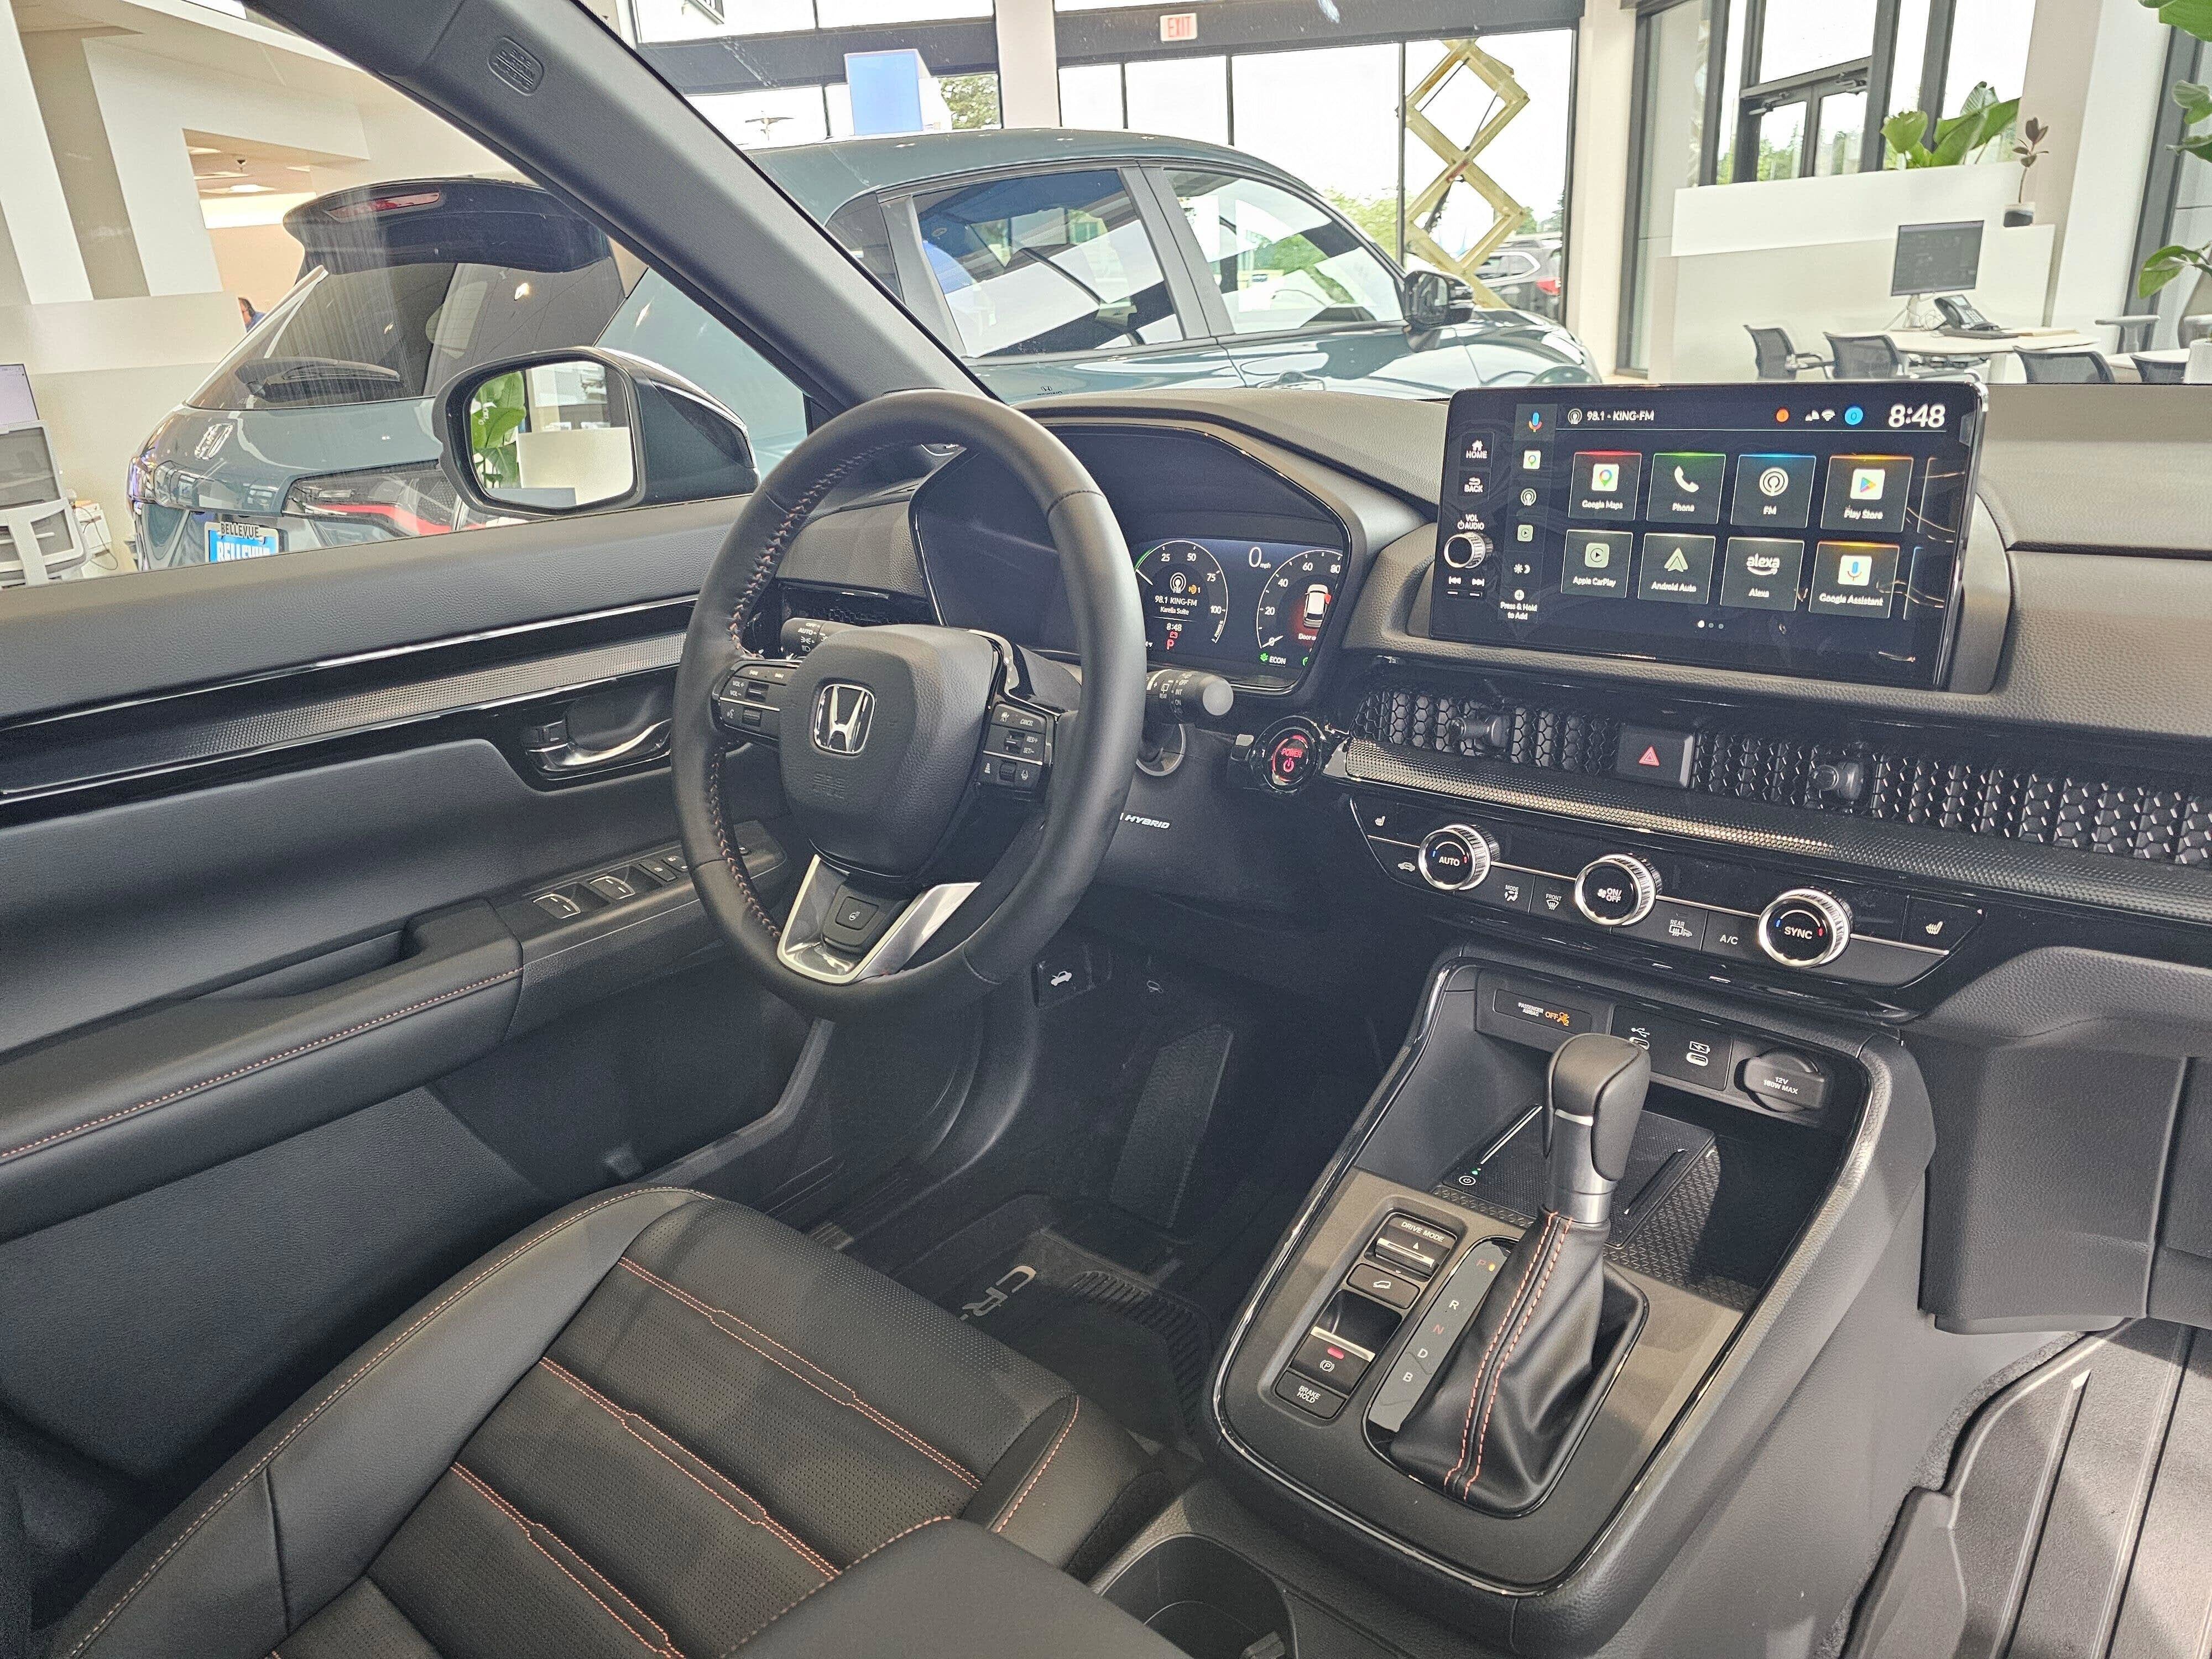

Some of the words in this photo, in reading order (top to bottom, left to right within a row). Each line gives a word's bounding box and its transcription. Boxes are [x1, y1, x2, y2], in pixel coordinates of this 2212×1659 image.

[1168, 16, 1192, 38] EXIT
[1587, 410, 1605, 421] 98.1
[1888, 403, 1945, 427] 8:48
[1466, 450, 1488, 459] HOME
[1464, 484, 1483, 493] BACK
[1582, 499, 1605, 509] Google
[1605, 500, 1623, 510] Maps
[1672, 502, 1695, 512] Phone
[1763, 505, 1777, 515] FM
[1844, 509, 1861, 520] Play
[1861, 509, 1884, 520] Store
[1465, 514, 1479, 522] VOL
[221, 523, 259, 538] BELLEVUE
[1465, 521, 1485, 530] AUDIO
[1161, 553, 1171, 562] 25
[1187, 552, 1197, 562] 50
[1249, 546, 1262, 567] 0
[1746, 553, 1780, 569] alexa
[1302, 562, 1313, 571] 60
[1331, 564, 1341, 573] 80
[1207, 573, 1216, 582] 75
[1277, 578, 1288, 587] 40
[1573, 576, 1592, 586] Apple
[1593, 578, 1616, 588] CarPlay
[1651, 581, 1679, 591] Android
[1679, 583, 1697, 592] Auto
[1749, 588, 1770, 598] Alexa
[1155, 595, 1168, 604] 98.1
[1170, 597, 1198, 607] KING-FM
[1819, 592, 1846, 604] Google
[1847, 594, 1884, 606] Assistant
[1211, 605, 1222, 614] 100
[1264, 607, 1275, 615] 20
[1500, 601, 1516, 610] Press
[1522, 603, 1538, 612] Hold
[1515, 612, 1528, 620] Add
[797, 627, 813, 635] AUTO
[1167, 623, 1182, 632] 8:48
[1167, 639, 1174, 650] P
[1269, 656, 1286, 665] ECON
[1281, 748, 1303, 758] POWER
[1124, 814, 1170, 829] HYBRID
[1438, 855, 1460, 867] AUTO
[1505, 884, 1519, 893] MODE
[1606, 888, 1622, 896] ON/
[1546, 893, 1562, 901] FRONT
[1606, 894, 1621, 902] OFF
[1784, 926, 1813, 940] SYNC
[1719, 934, 1739, 945] A/C
[1545, 1011, 1559, 1020] OFF
[1775, 1077, 1789, 1085] 12V
[1781, 1085, 1798, 1094] MAX
[1401, 1220, 1423, 1234] DRIVE
[1422, 1229, 1445, 1243] MODE
[1448, 1300, 1459, 1310] R
[1432, 1324, 1444, 1335] N
[1417, 1348, 1428, 1359] D
[1402, 1371, 1413, 1383] B
[1296, 1391, 1316, 1404] HOLD
[1298, 1385, 1321, 1400] BRAKE
